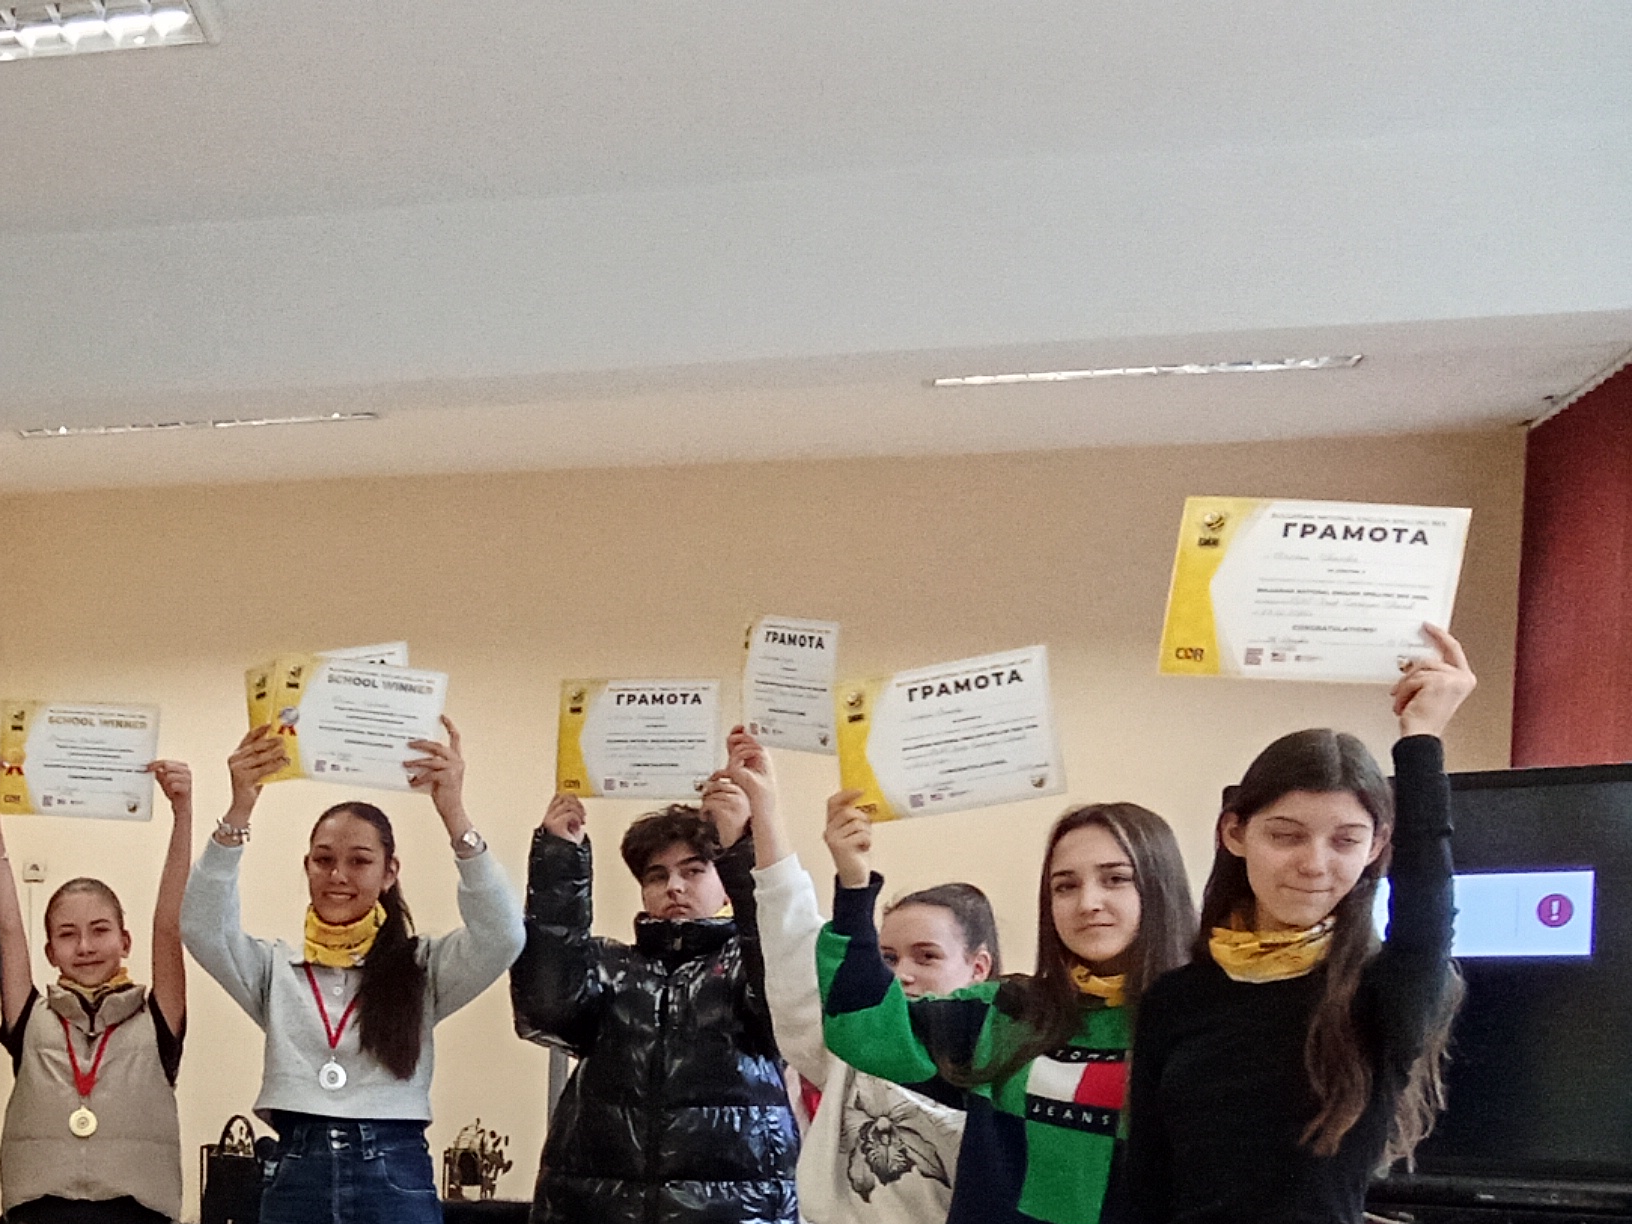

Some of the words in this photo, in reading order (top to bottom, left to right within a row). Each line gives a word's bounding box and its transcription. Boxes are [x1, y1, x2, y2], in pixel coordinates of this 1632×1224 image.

[1282, 522, 1429, 546] ГРАМОТА
[764, 630, 826, 650] ГРАМОТА
[327, 673, 379, 689] SCHOOL
[382, 681, 434, 695] WINNER
[908, 669, 1024, 702] ГРАМОТА
[616, 693, 703, 705] ГРАМОТА
[48, 716, 96, 727] SCHOOL
[99, 718, 148, 730] WINNER
[1032, 1102, 1110, 1125] JEANS
